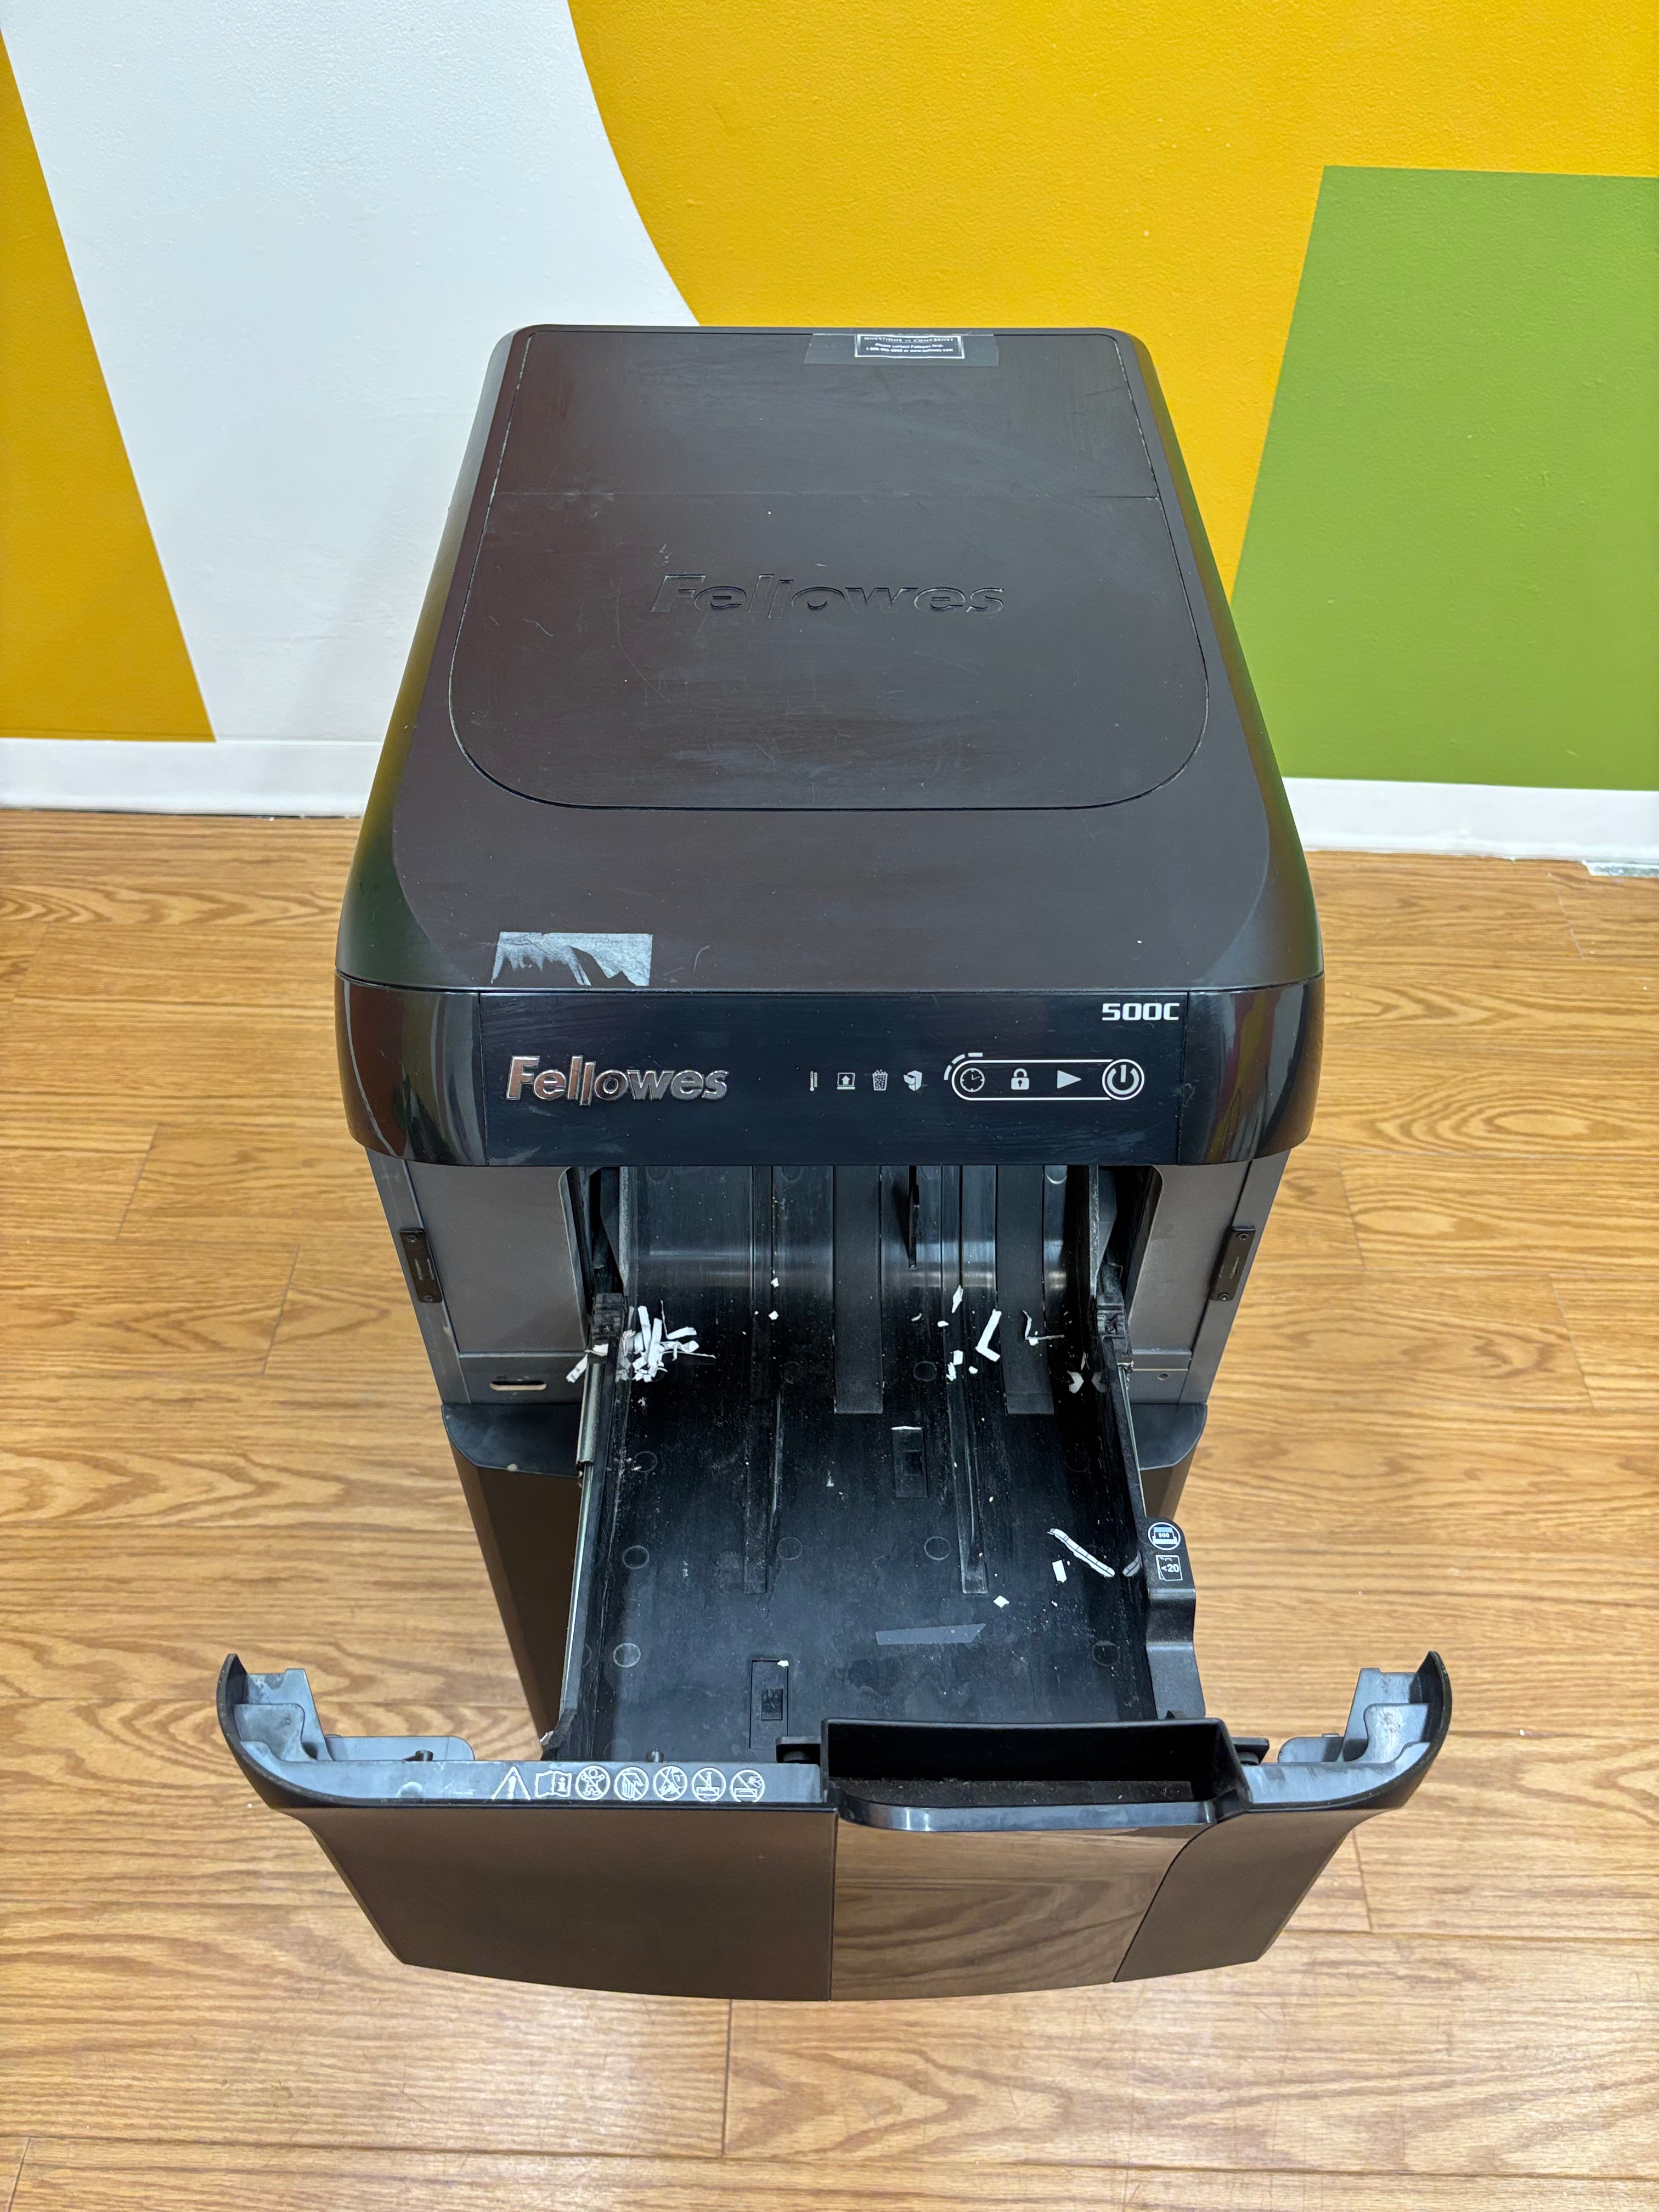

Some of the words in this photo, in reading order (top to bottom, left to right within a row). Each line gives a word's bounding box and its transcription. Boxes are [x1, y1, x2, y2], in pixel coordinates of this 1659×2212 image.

[651, 574, 1005, 619] Fellowes
[1102, 1003, 1180, 1021] 500C
[505, 1055, 730, 1107] Fellowes
